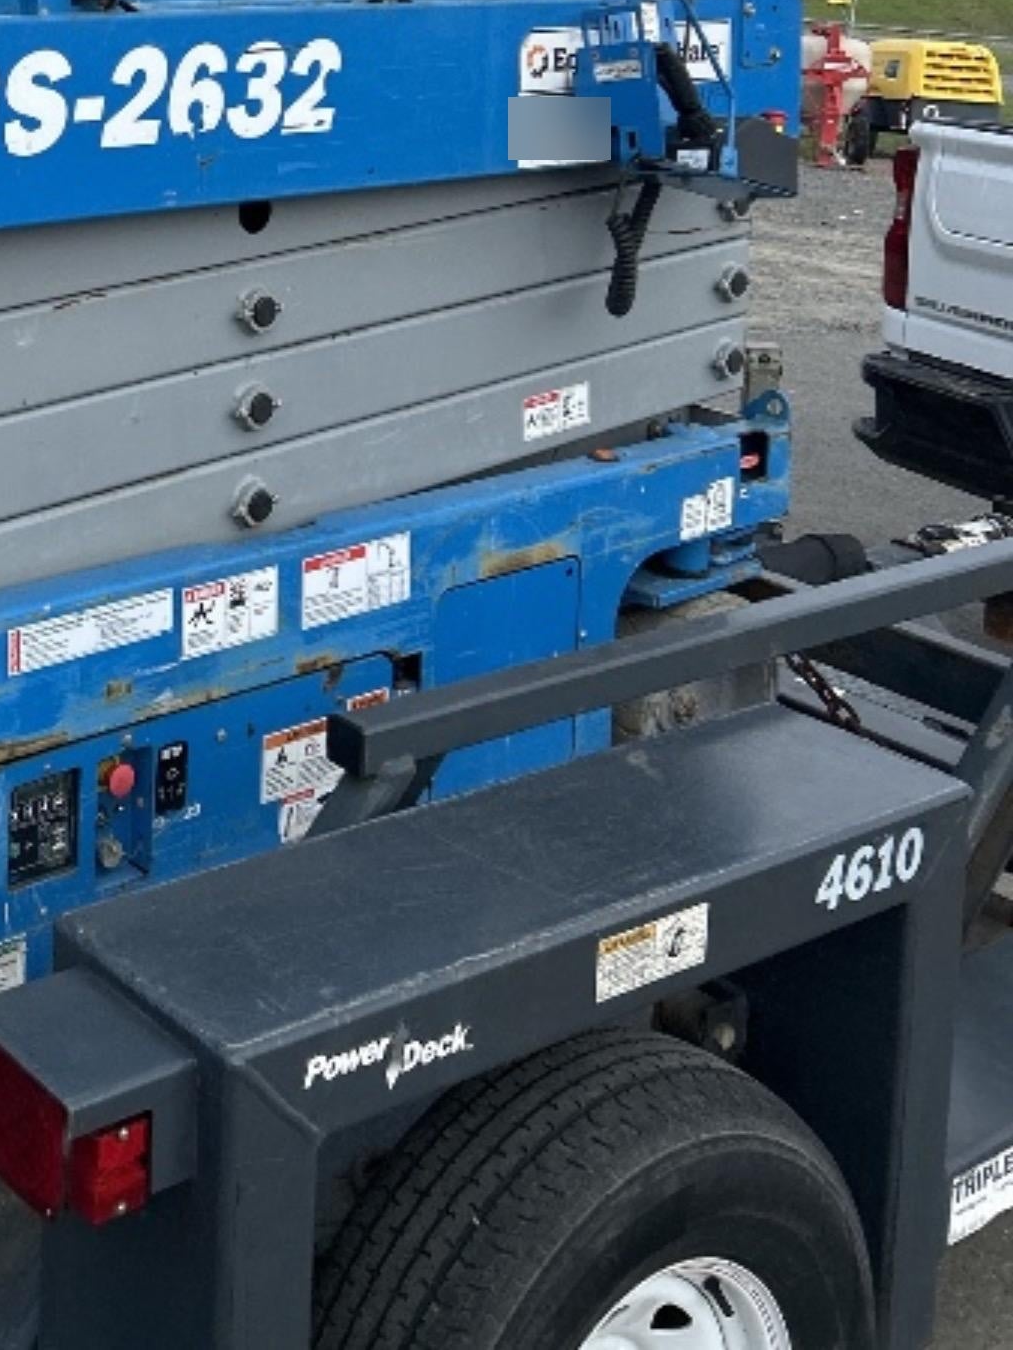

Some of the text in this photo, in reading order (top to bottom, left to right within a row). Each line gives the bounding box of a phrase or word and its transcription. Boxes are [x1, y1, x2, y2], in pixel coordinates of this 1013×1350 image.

[814, 826, 924, 910] 4610
[303, 1021, 469, 1090] Power Deck
